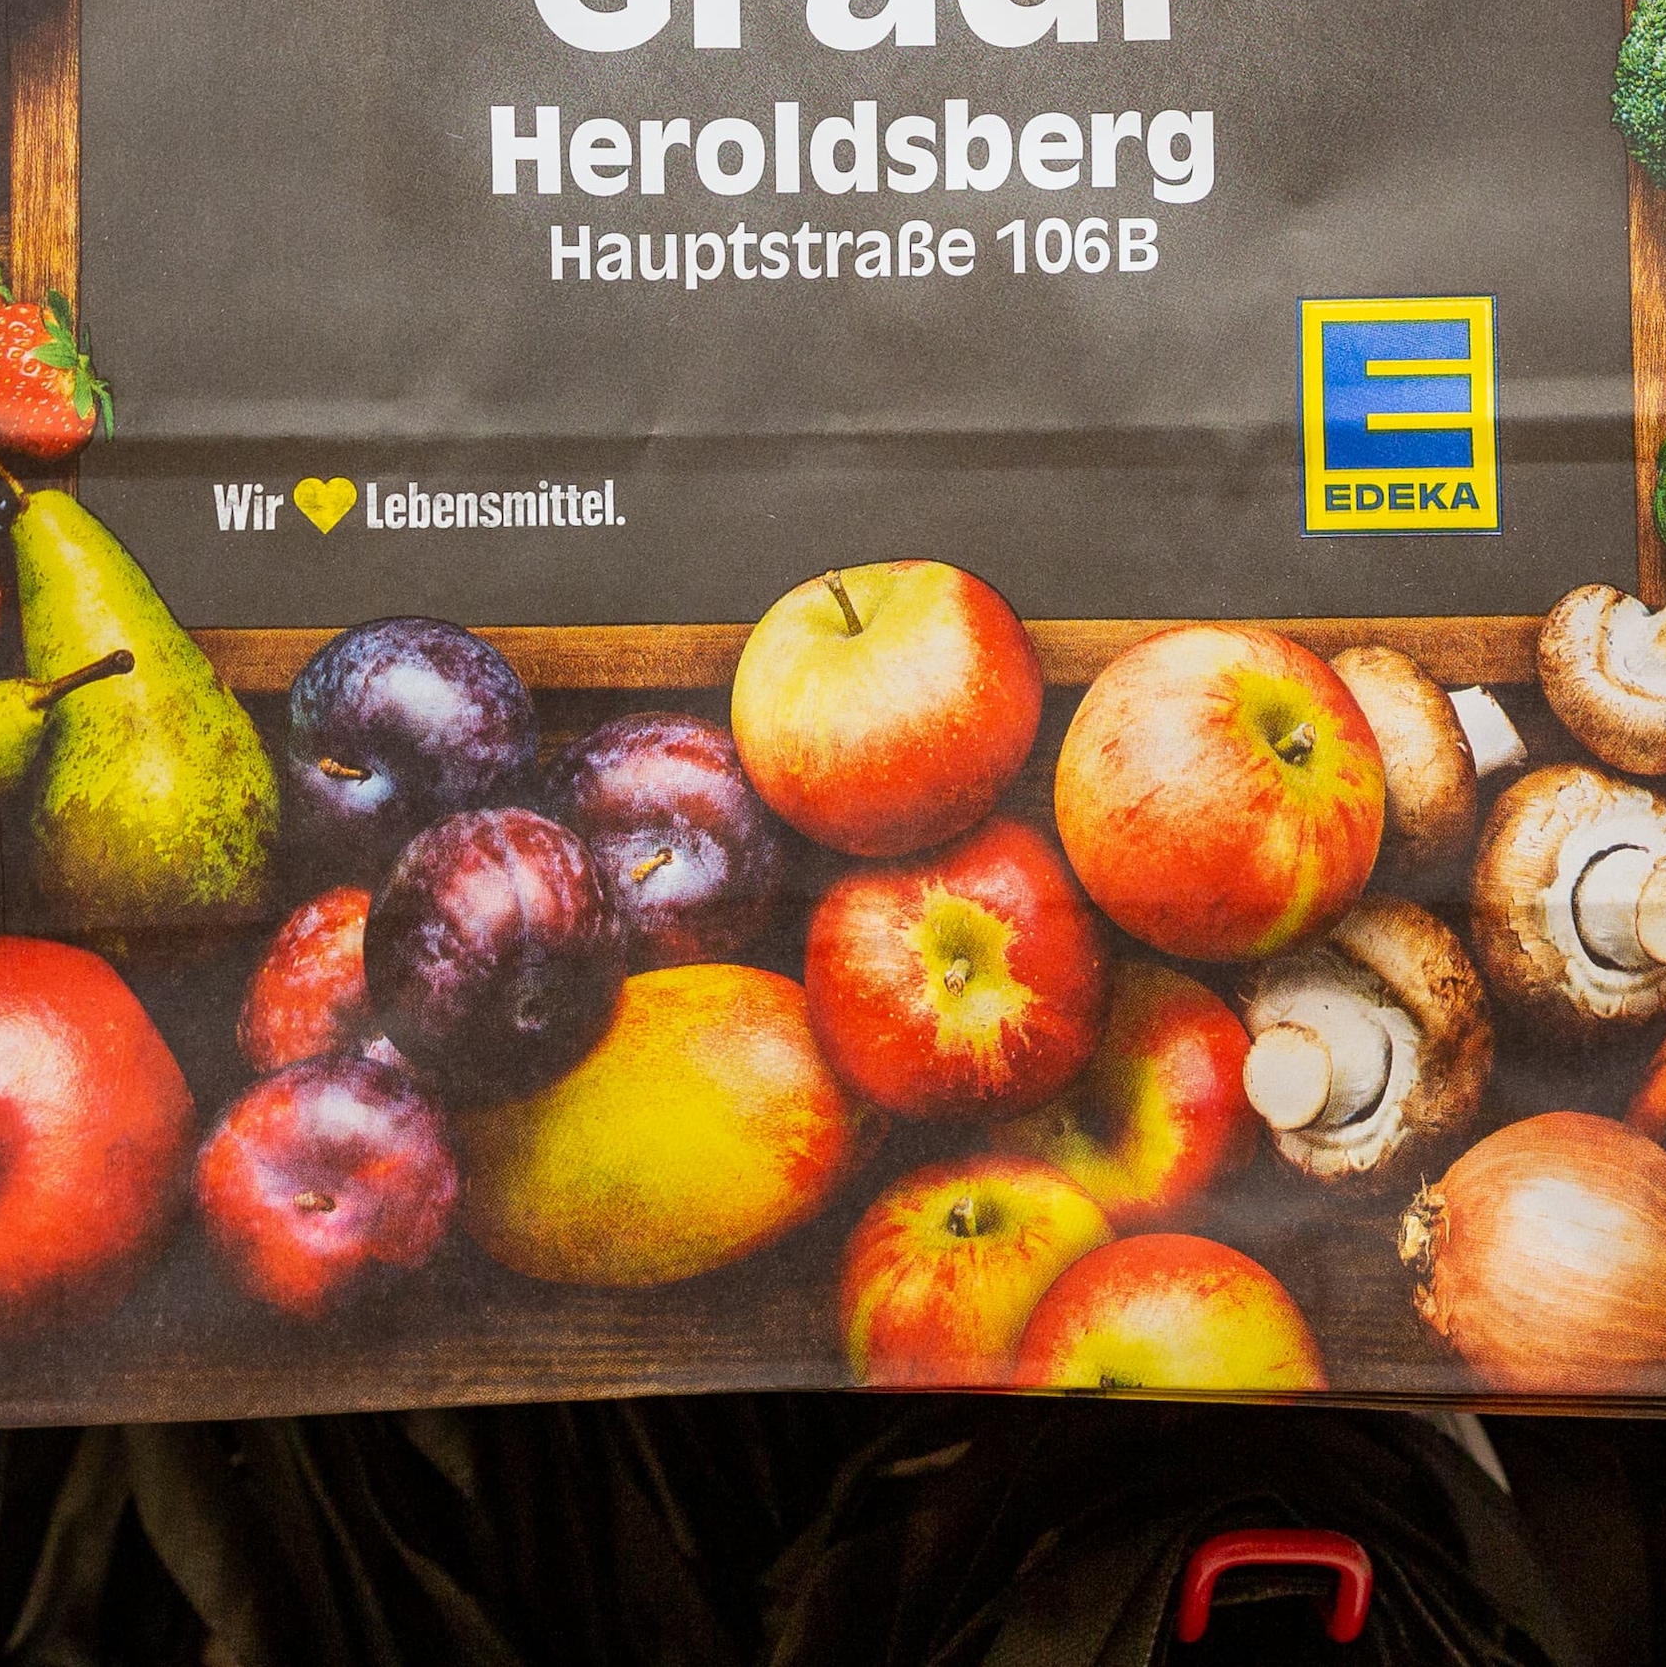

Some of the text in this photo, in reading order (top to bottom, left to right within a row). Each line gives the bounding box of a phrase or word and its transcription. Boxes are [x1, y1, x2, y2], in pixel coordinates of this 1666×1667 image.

[489, 97, 1216, 205] Heroldsberg
[549, 216, 1160, 291] Hauptstraße 106B
[212, 478, 627, 532] Wir Lebensmittel.
[1323, 481, 1481, 512] EDEKA
